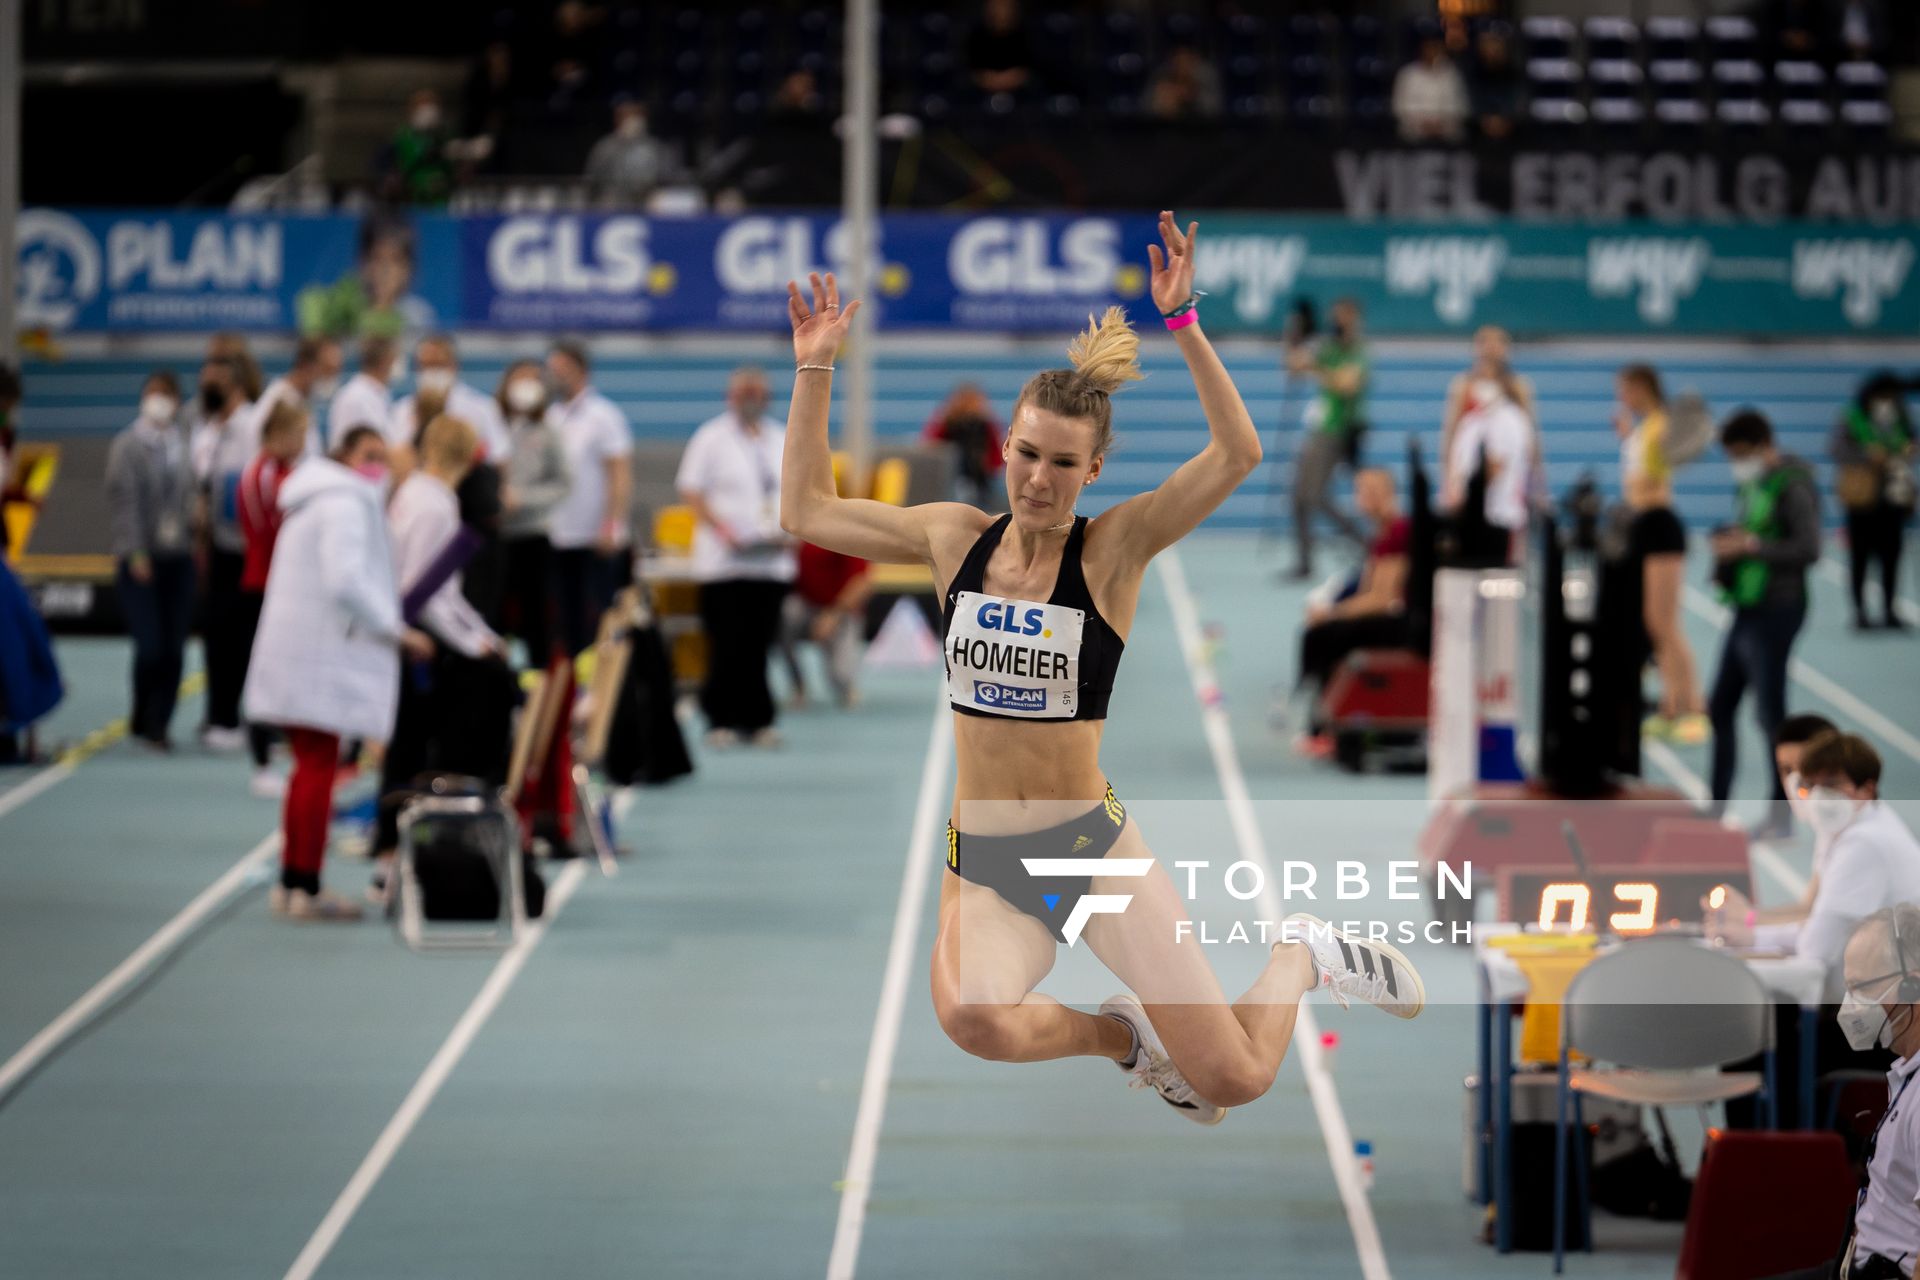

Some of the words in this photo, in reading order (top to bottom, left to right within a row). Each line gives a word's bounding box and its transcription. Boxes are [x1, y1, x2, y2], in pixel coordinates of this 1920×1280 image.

[1335, 150, 1491, 220] VIEL
[1511, 153, 1788, 222] ERFOLG
[107, 220, 283, 289] PLAN
[953, 637, 1068, 680] HOMEIER
[1002, 688, 1043, 702] PLAN
[1062, 690, 1071, 705] 145
